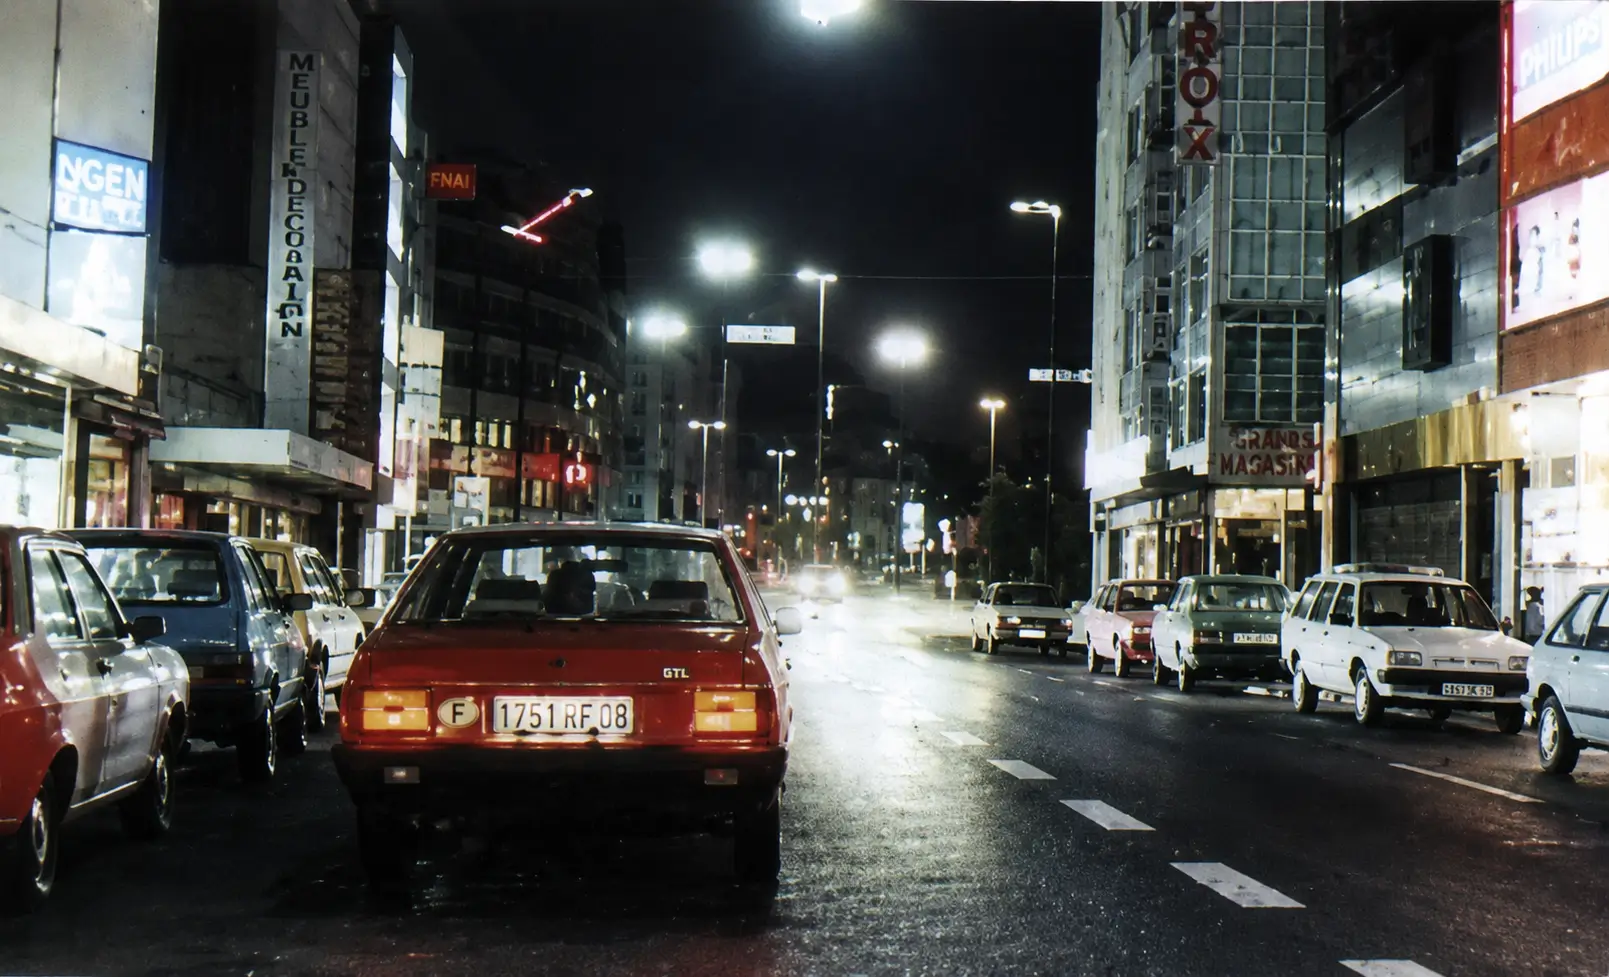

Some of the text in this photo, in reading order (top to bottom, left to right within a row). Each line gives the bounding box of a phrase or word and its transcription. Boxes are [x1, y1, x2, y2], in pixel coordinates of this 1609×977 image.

[663, 667, 690, 679] GTL
[452, 703, 465, 723] F
[501, 703, 628, 729] 1751 RF 08
